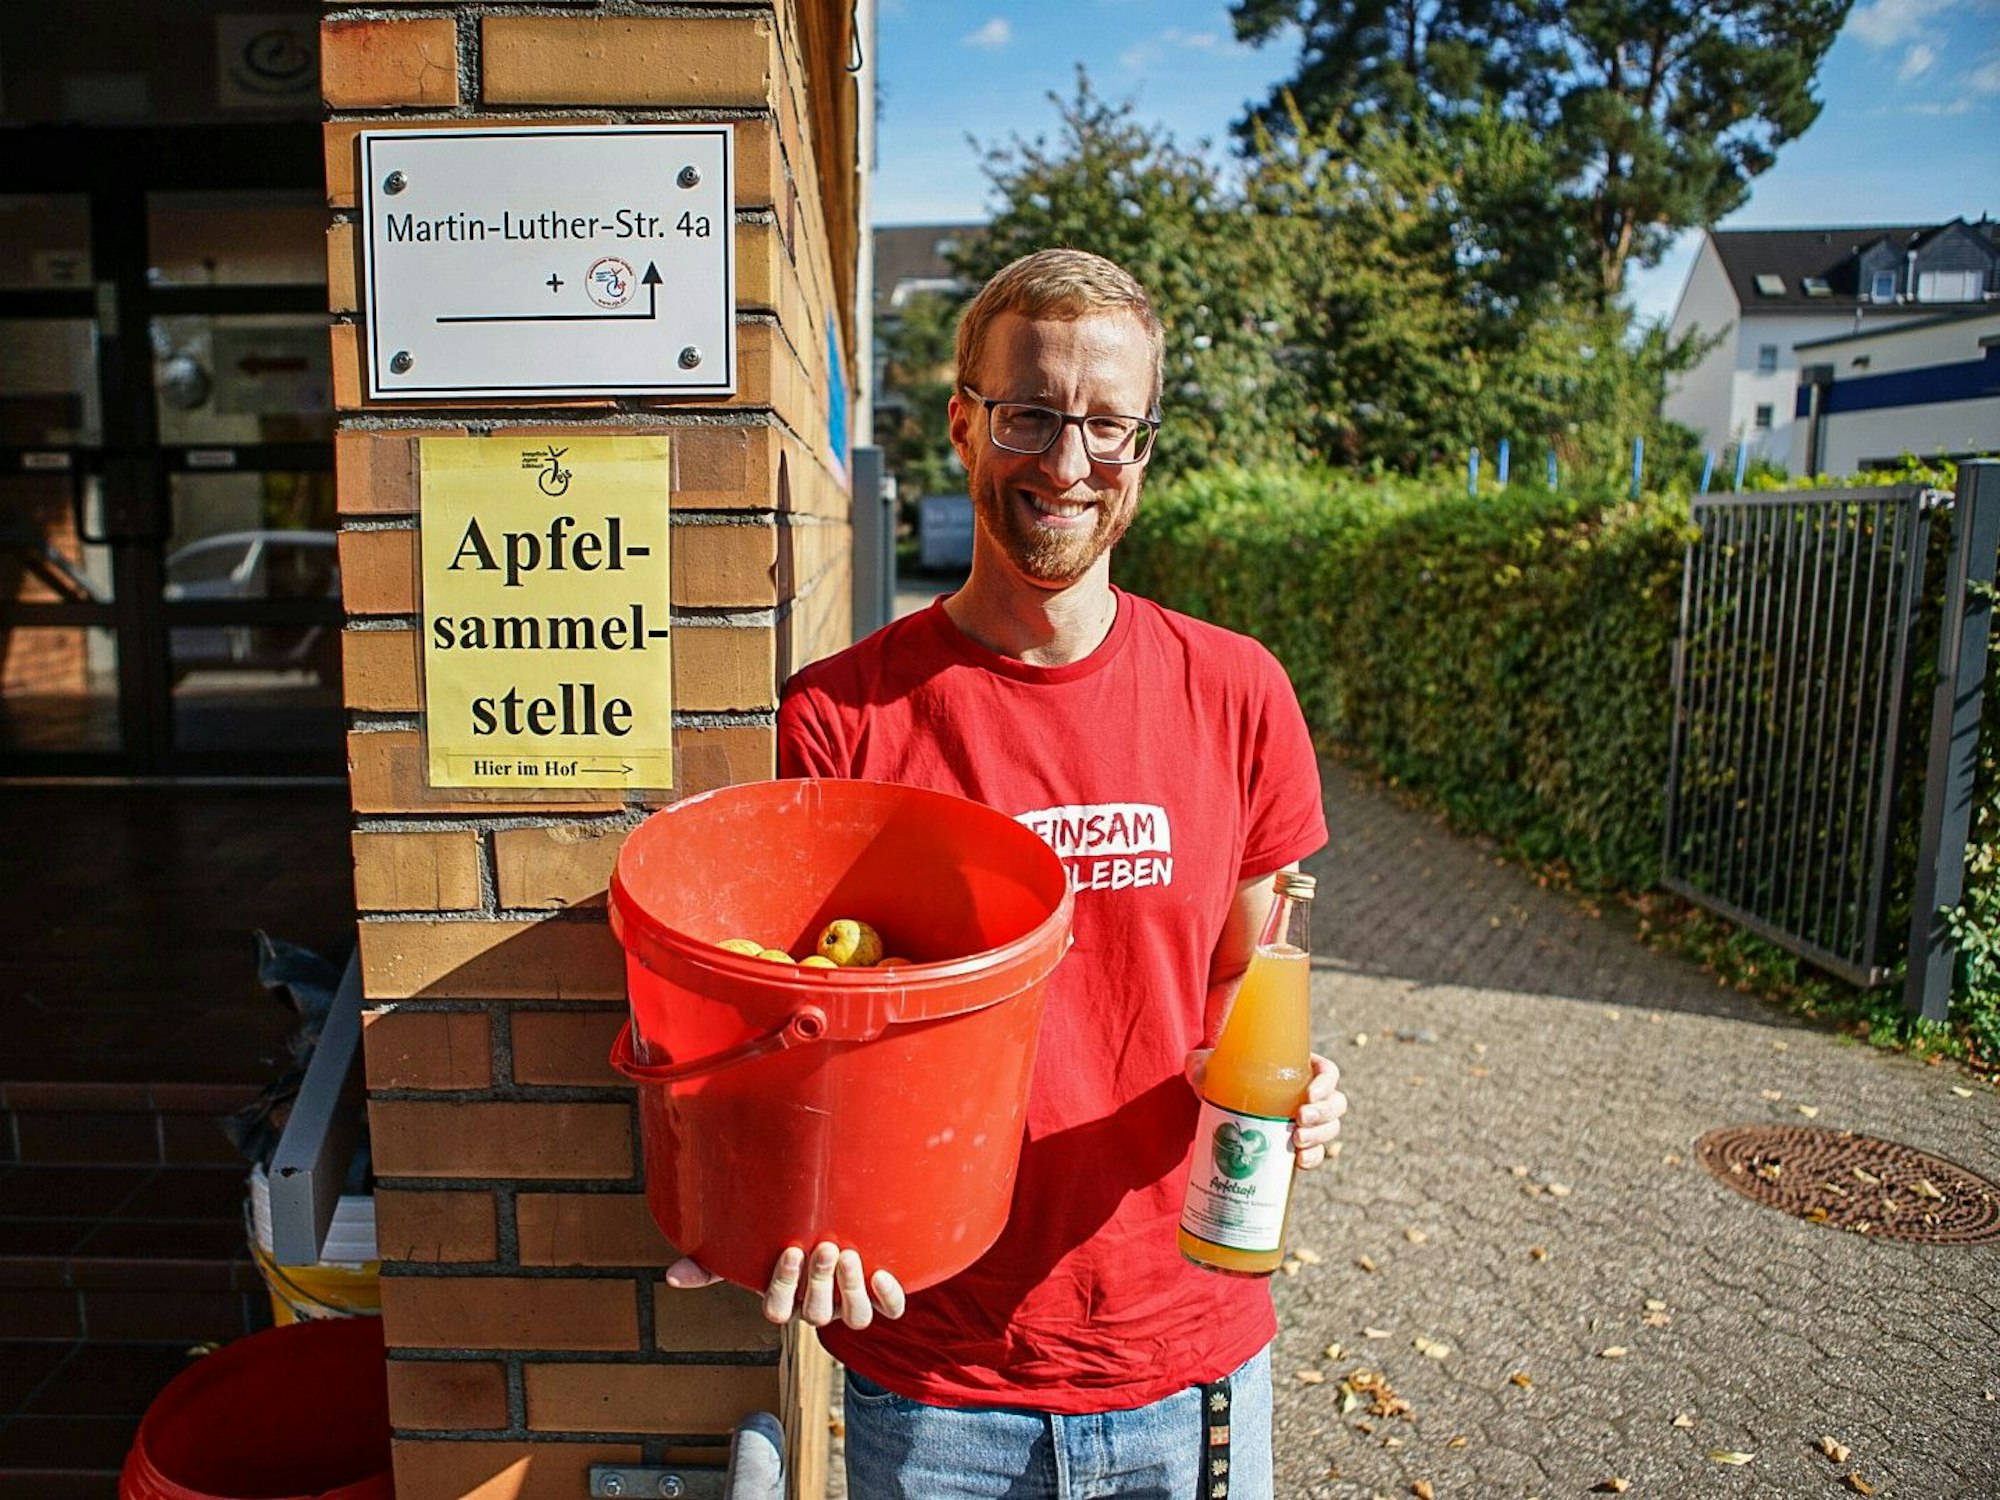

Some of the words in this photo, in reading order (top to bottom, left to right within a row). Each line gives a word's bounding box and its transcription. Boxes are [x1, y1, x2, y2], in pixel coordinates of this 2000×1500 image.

[387, 209, 665, 242] Martin-Luther-Str.
[676, 211, 710, 238] 4a
[447, 516, 650, 587] Apfel-
[433, 604, 669, 650] sammel-
[472, 683, 633, 736] stelle
[474, 761, 512, 776] Hier
[518, 761, 539, 776] im
[545, 761, 579, 776] Hof
[1025, 812, 1155, 850] EINSAM
[1065, 857, 1173, 893] LEBEN
[1210, 1177, 1256, 1198] Apfelsaft
